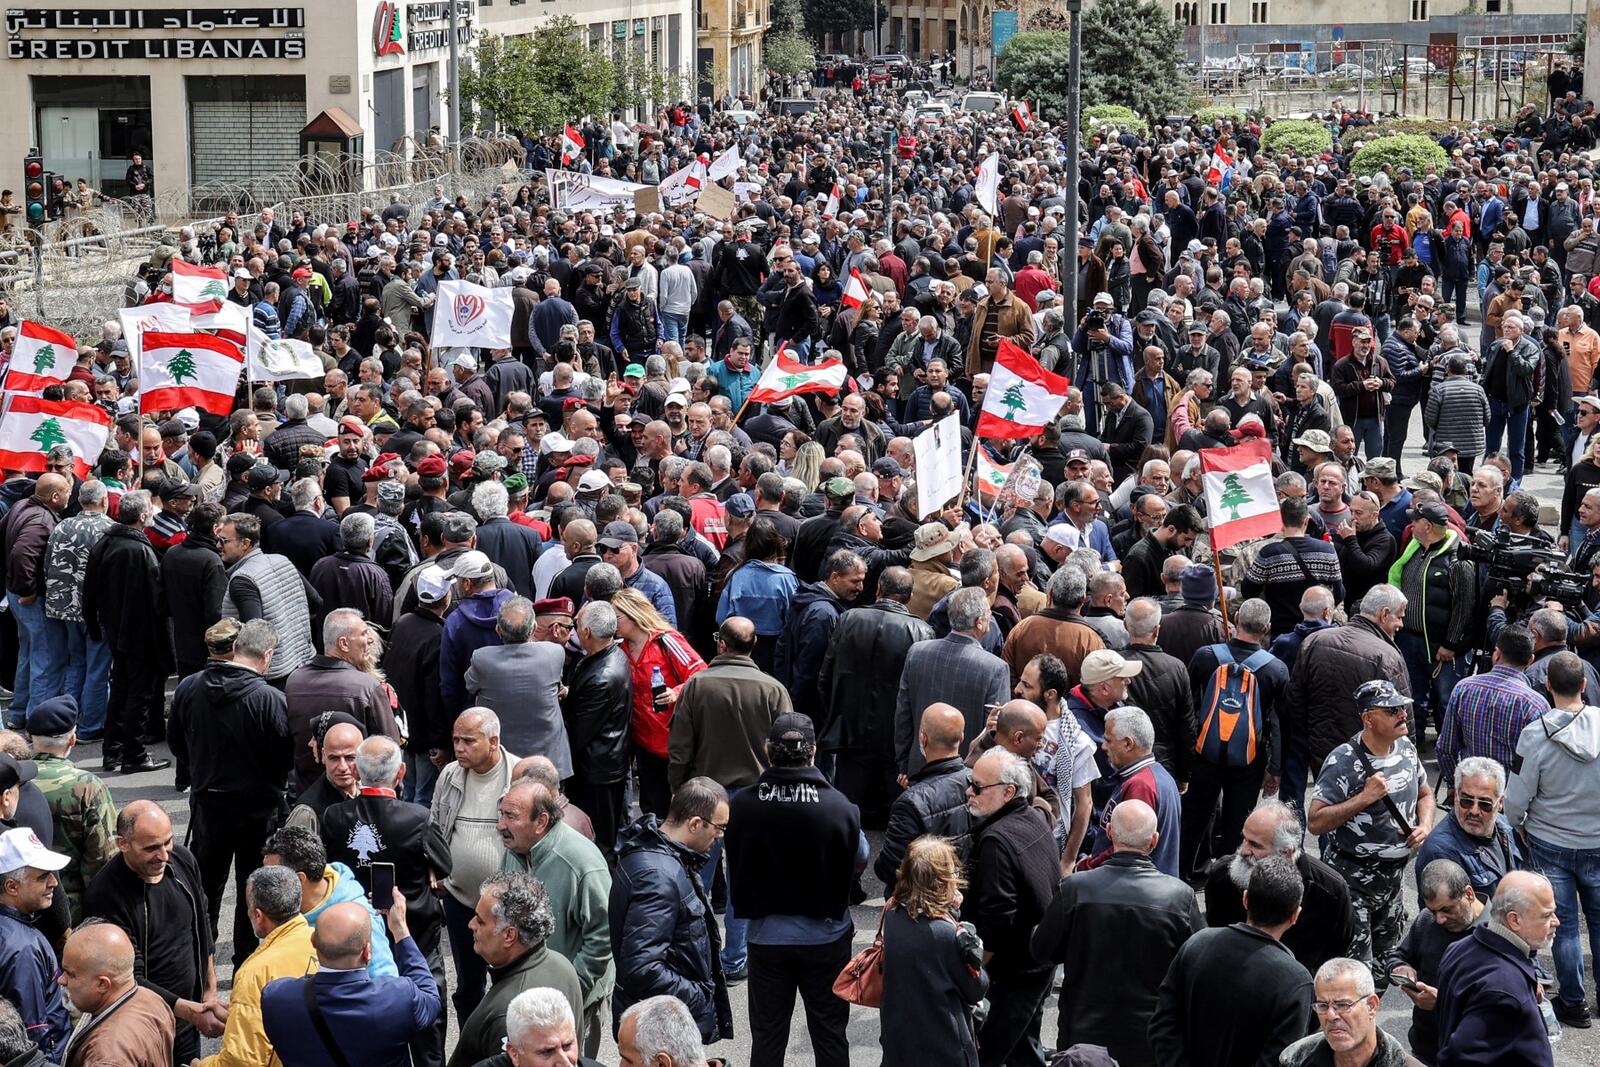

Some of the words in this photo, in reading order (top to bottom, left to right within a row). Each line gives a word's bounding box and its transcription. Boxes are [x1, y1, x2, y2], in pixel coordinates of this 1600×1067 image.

[5, 10, 143, 39] اللبناني
[163, 9, 303, 31] الاعتماد
[7, 40, 130, 59] CREDIT
[145, 39, 303, 59] LIBANAIS
[414, 32, 442, 50] CREDIT
[758, 782, 820, 803] CALVIN
